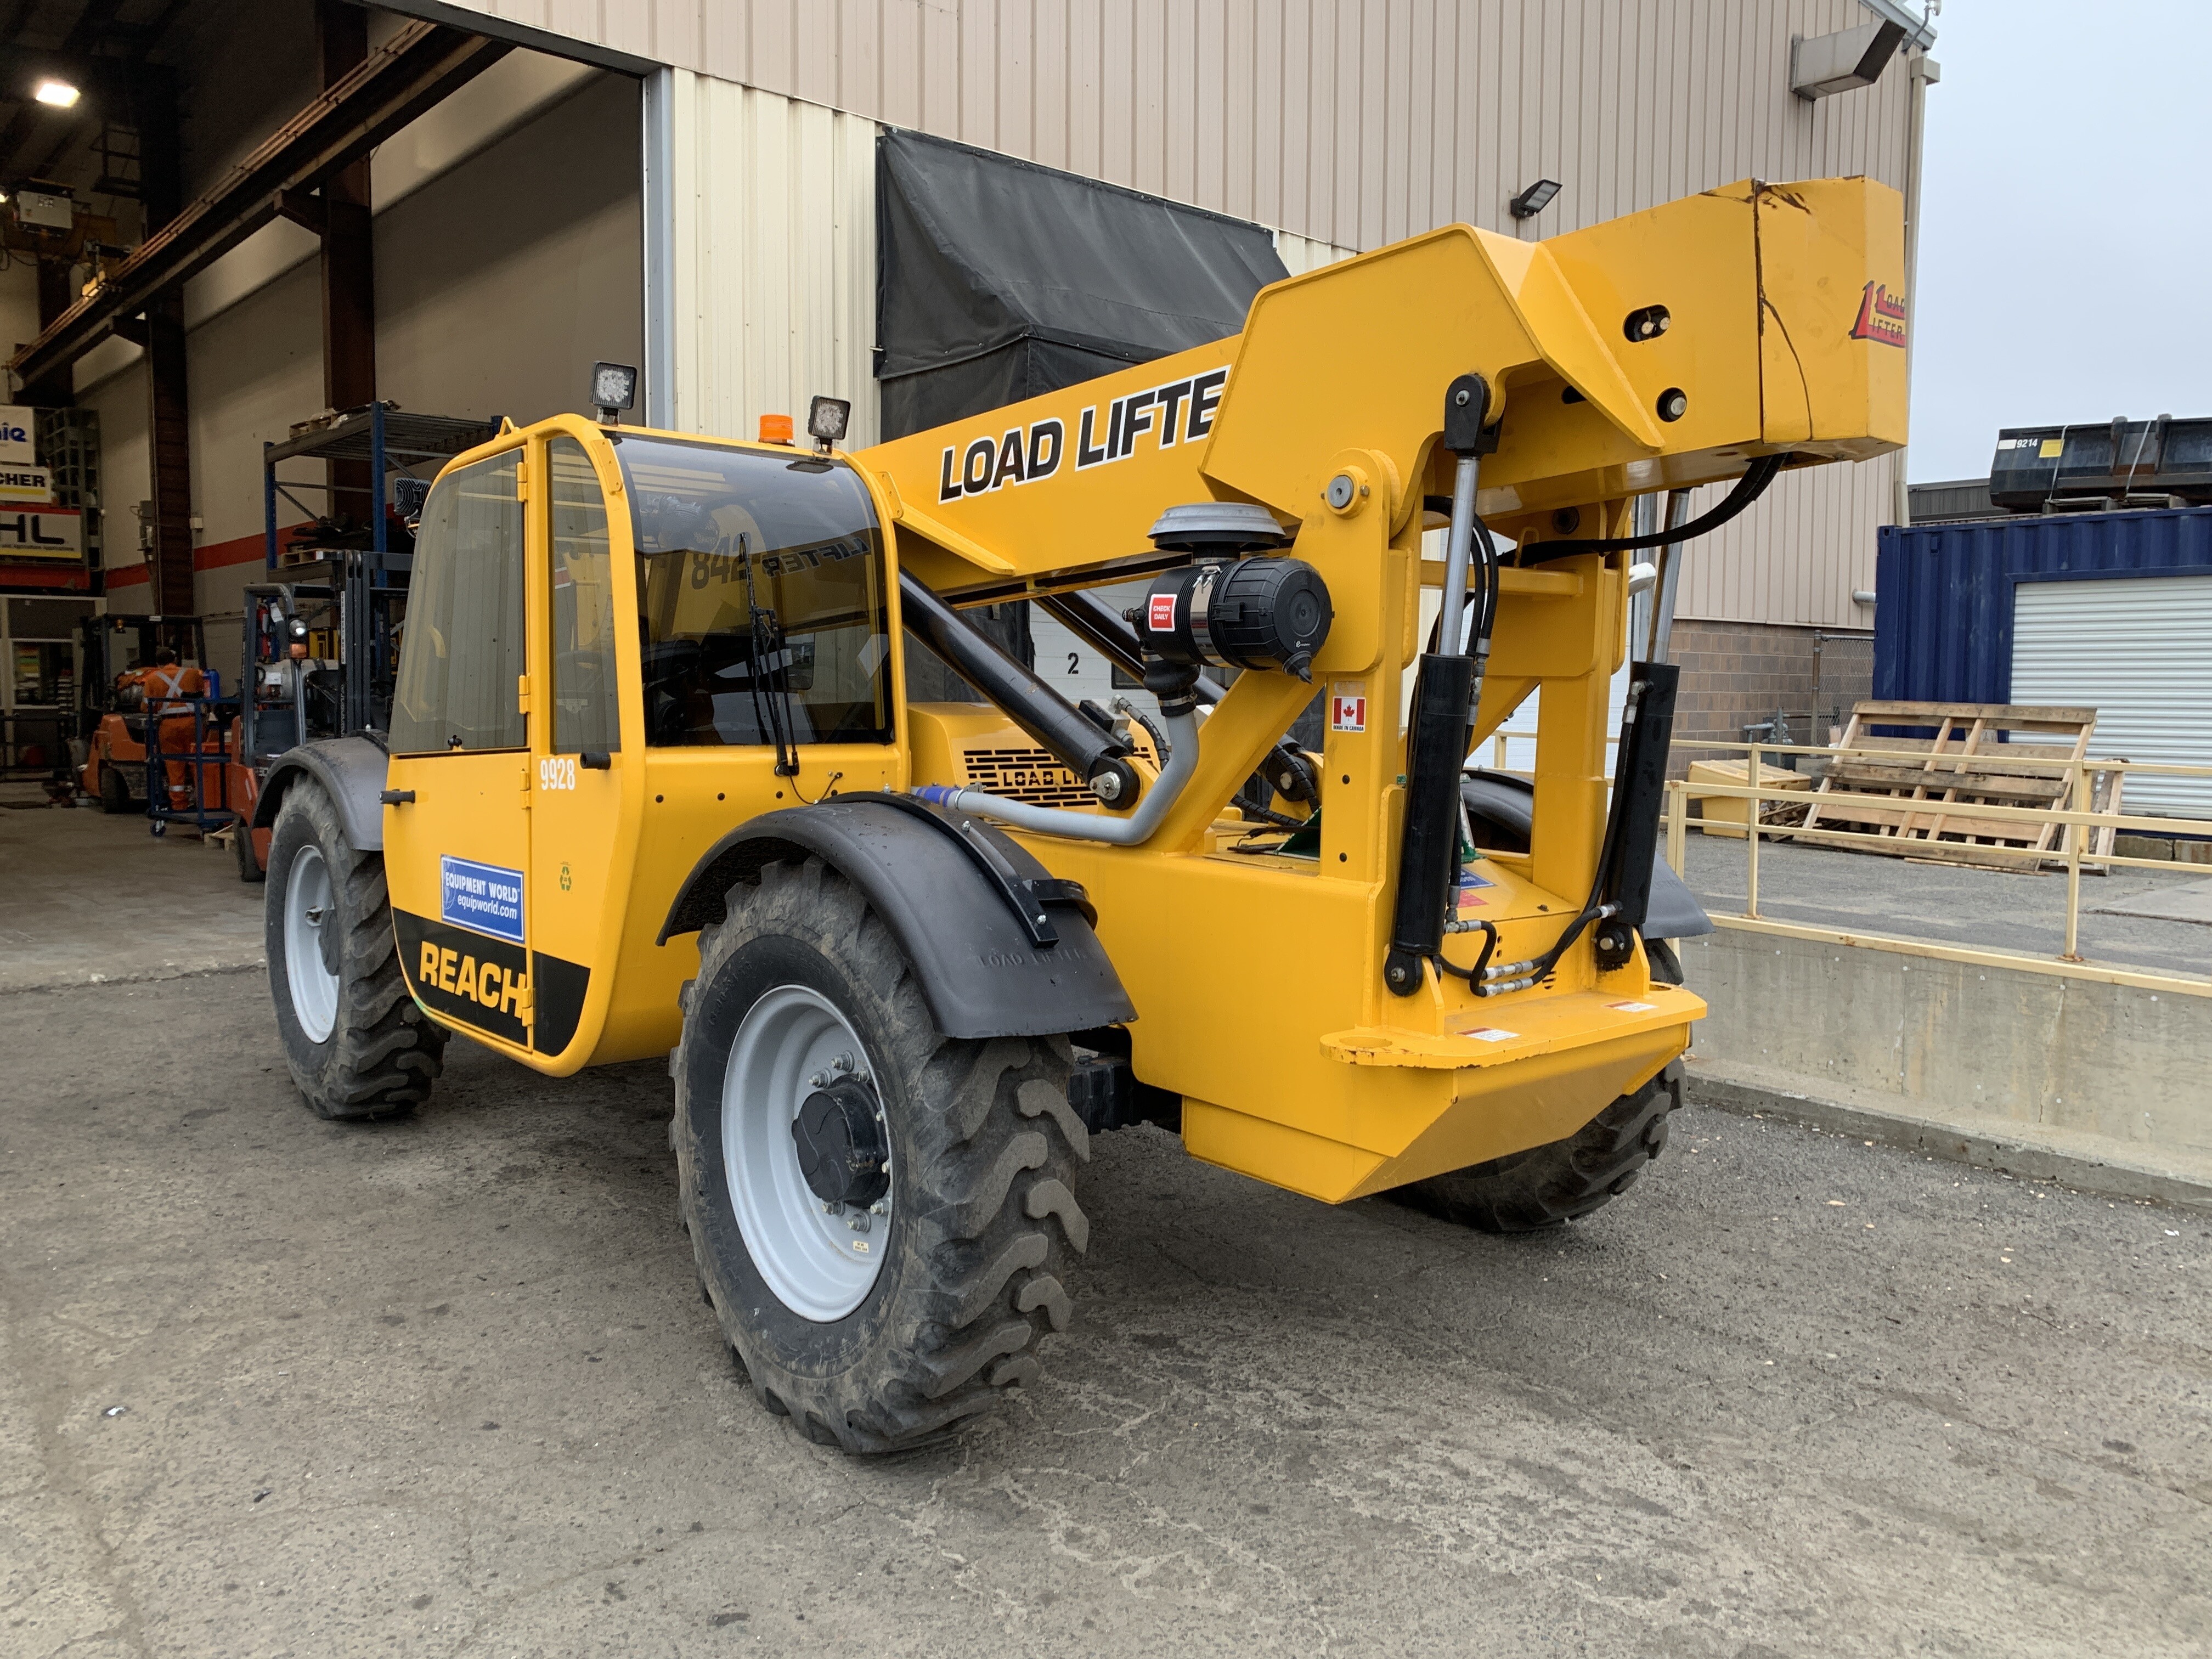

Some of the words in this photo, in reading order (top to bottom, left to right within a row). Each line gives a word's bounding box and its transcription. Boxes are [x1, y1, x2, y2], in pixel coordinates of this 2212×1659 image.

[938, 417, 1065, 505] LOAD
[1075, 364, 1232, 472] LIFTE
[2017, 438, 2038, 448] 9214
[1068, 652, 1079, 674] 2
[540, 759, 575, 790] 9928
[1003, 771, 1054, 786] LOAD
[445, 872, 486, 896] EQUIPMENT
[488, 882, 518, 904] WORLD
[457, 894, 517, 920] equipworld.com
[419, 940, 527, 1019] REACH
